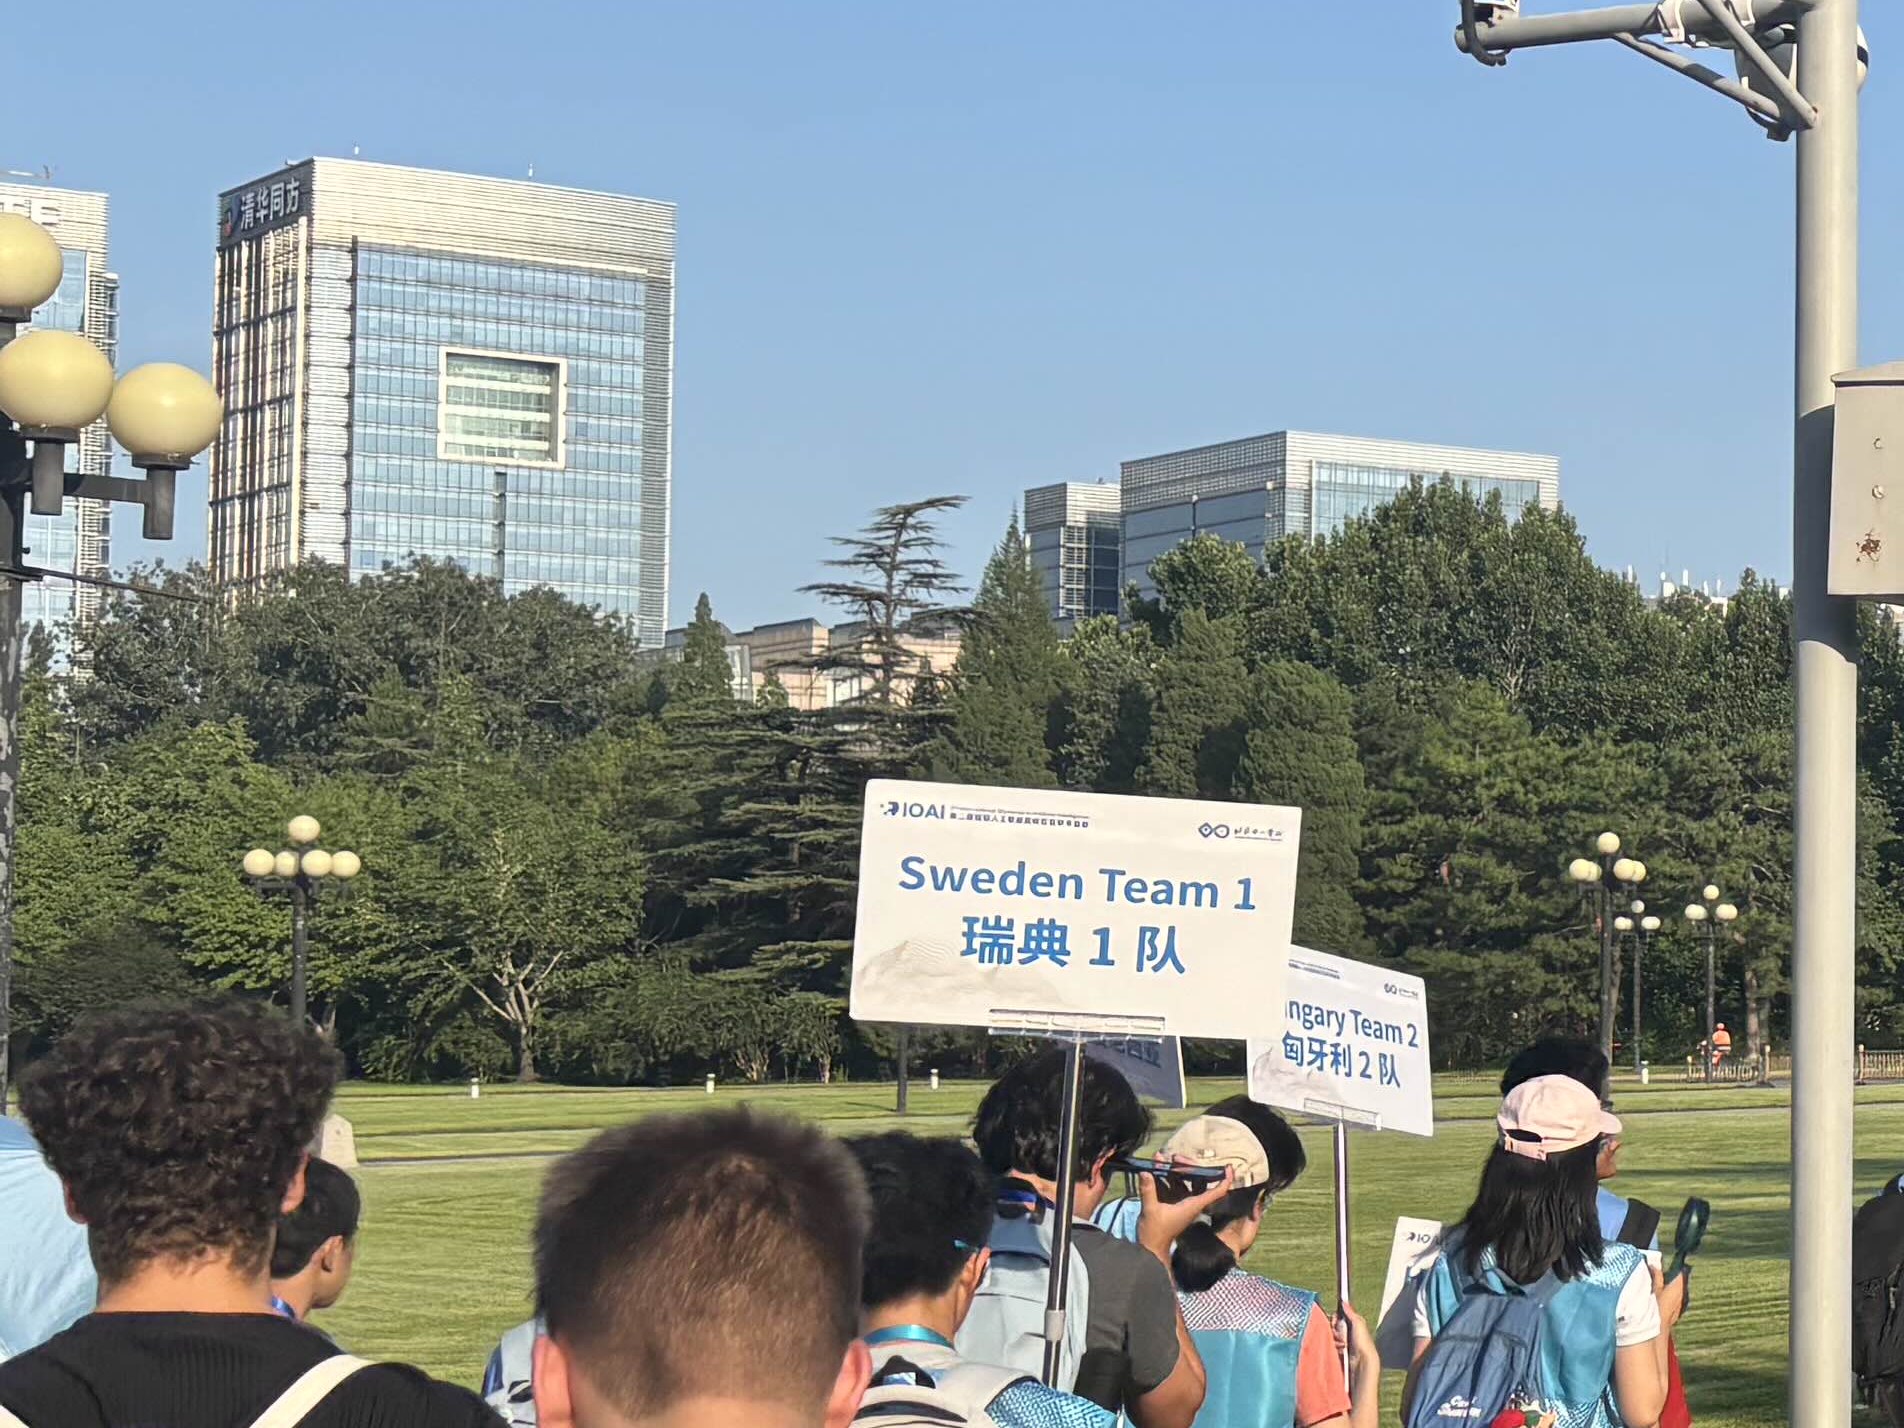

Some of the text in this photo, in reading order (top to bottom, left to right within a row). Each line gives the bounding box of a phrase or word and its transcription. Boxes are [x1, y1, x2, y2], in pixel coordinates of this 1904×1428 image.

[241, 177, 300, 229] 清华同方
[903, 802, 945, 819] IOAI
[899, 856, 1256, 911] Sweden Team 1
[960, 915, 1187, 974] 瑞典 1 队
[1285, 999, 1419, 1048] ngary Team 2
[1282, 1031, 1401, 1088] 匈牙利 2 队
